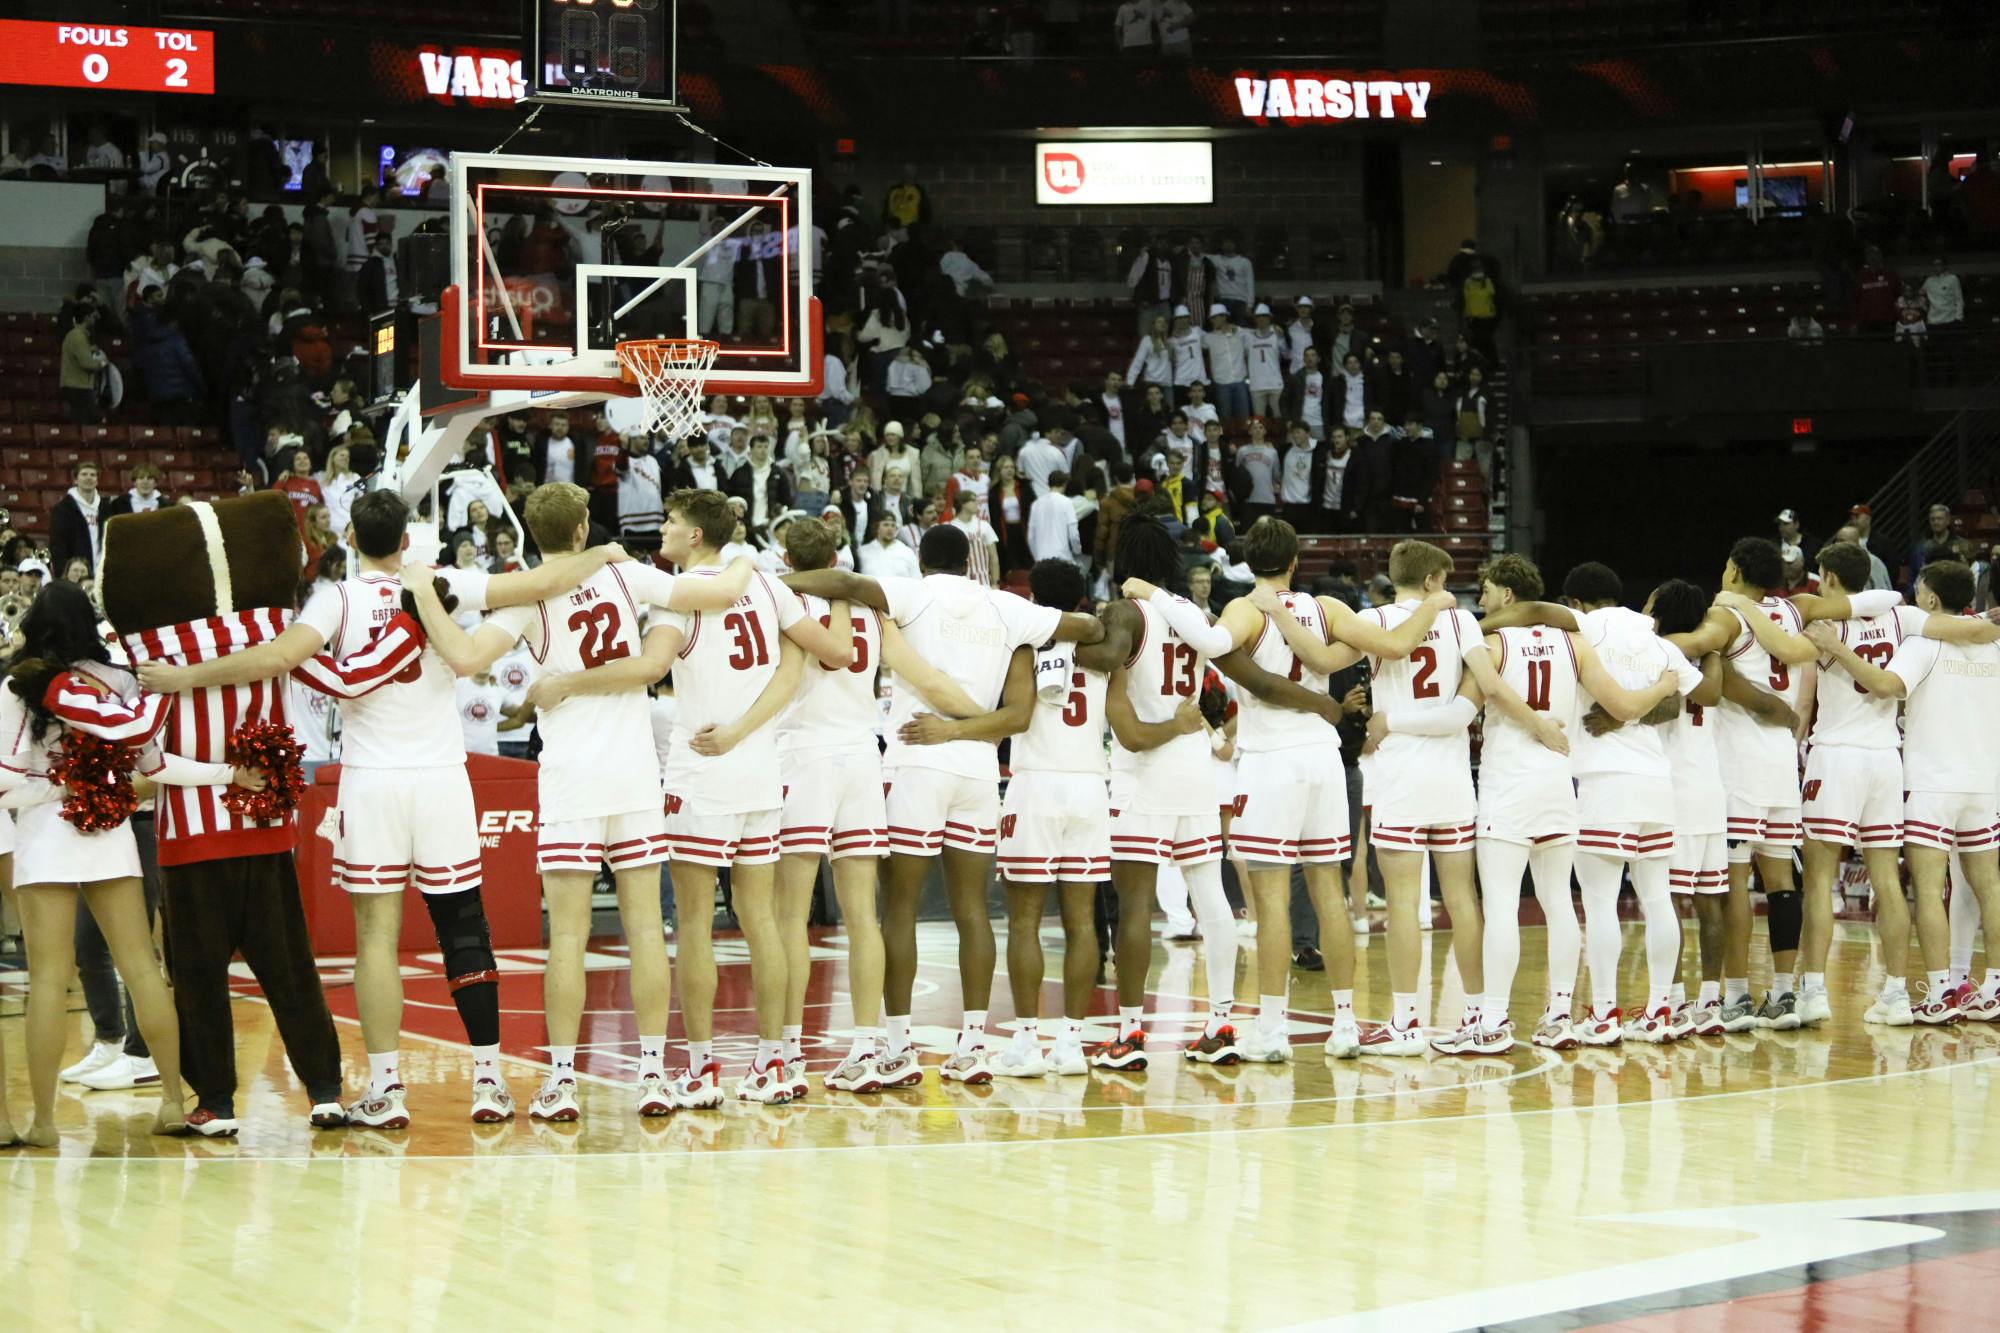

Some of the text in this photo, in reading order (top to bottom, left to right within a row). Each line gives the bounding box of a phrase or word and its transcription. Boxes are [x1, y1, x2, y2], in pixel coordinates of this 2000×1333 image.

[58, 26, 198, 51] FOULS TOL
[82, 53, 188, 87] 0 2
[571, 86, 639, 98] DAKTRONICS
[1235, 77, 1431, 119] VARSITY
[567, 601, 630, 670] 22
[724, 610, 769, 670] 31
[1161, 643, 1198, 697] 13
[1410, 646, 1440, 700] 2
[1526, 660, 1552, 711] 11
[1062, 672, 1088, 727] 5
